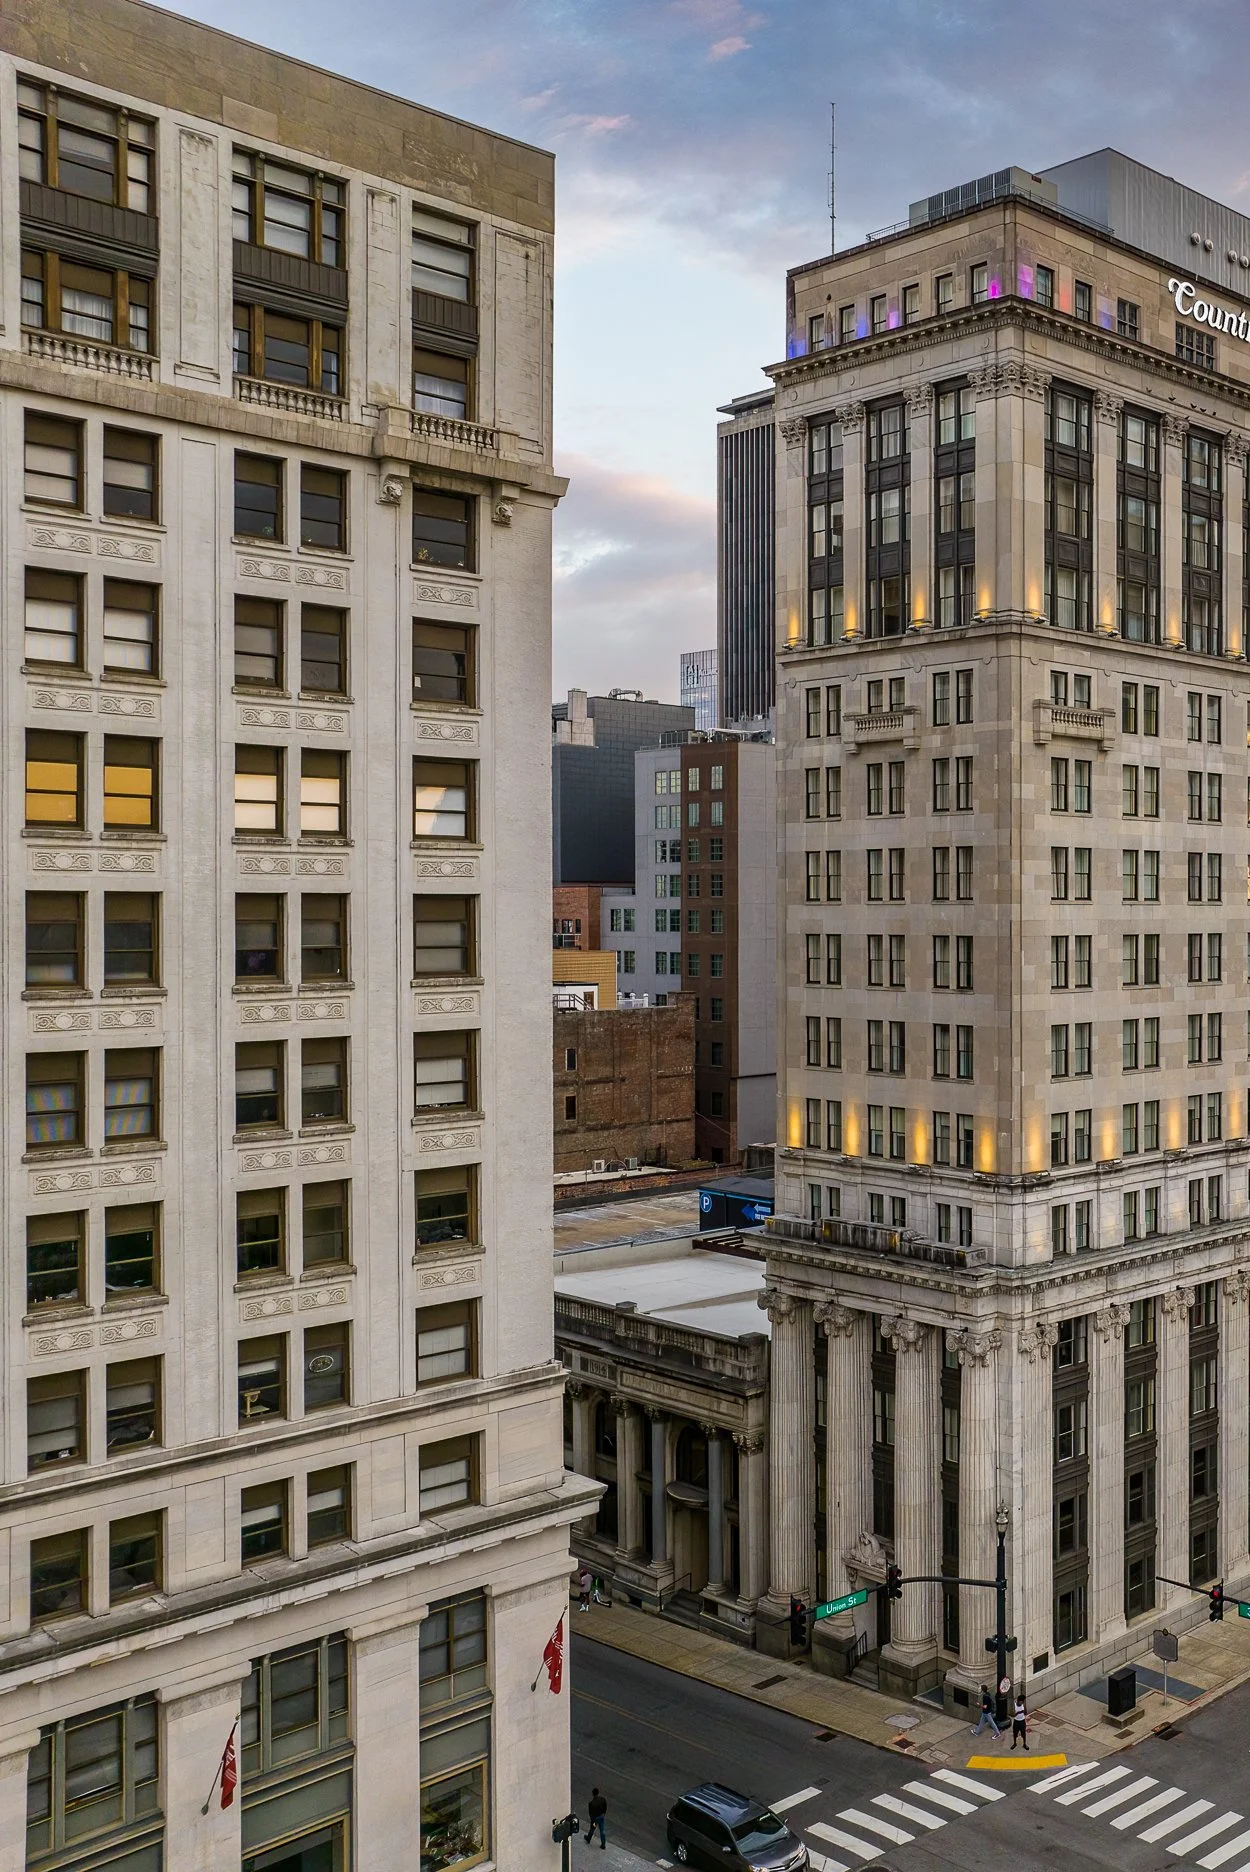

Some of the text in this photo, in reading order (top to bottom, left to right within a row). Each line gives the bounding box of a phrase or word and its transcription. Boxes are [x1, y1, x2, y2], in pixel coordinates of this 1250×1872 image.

[703, 1196, 710, 1208] P
[827, 1596, 857, 1614] Union St
